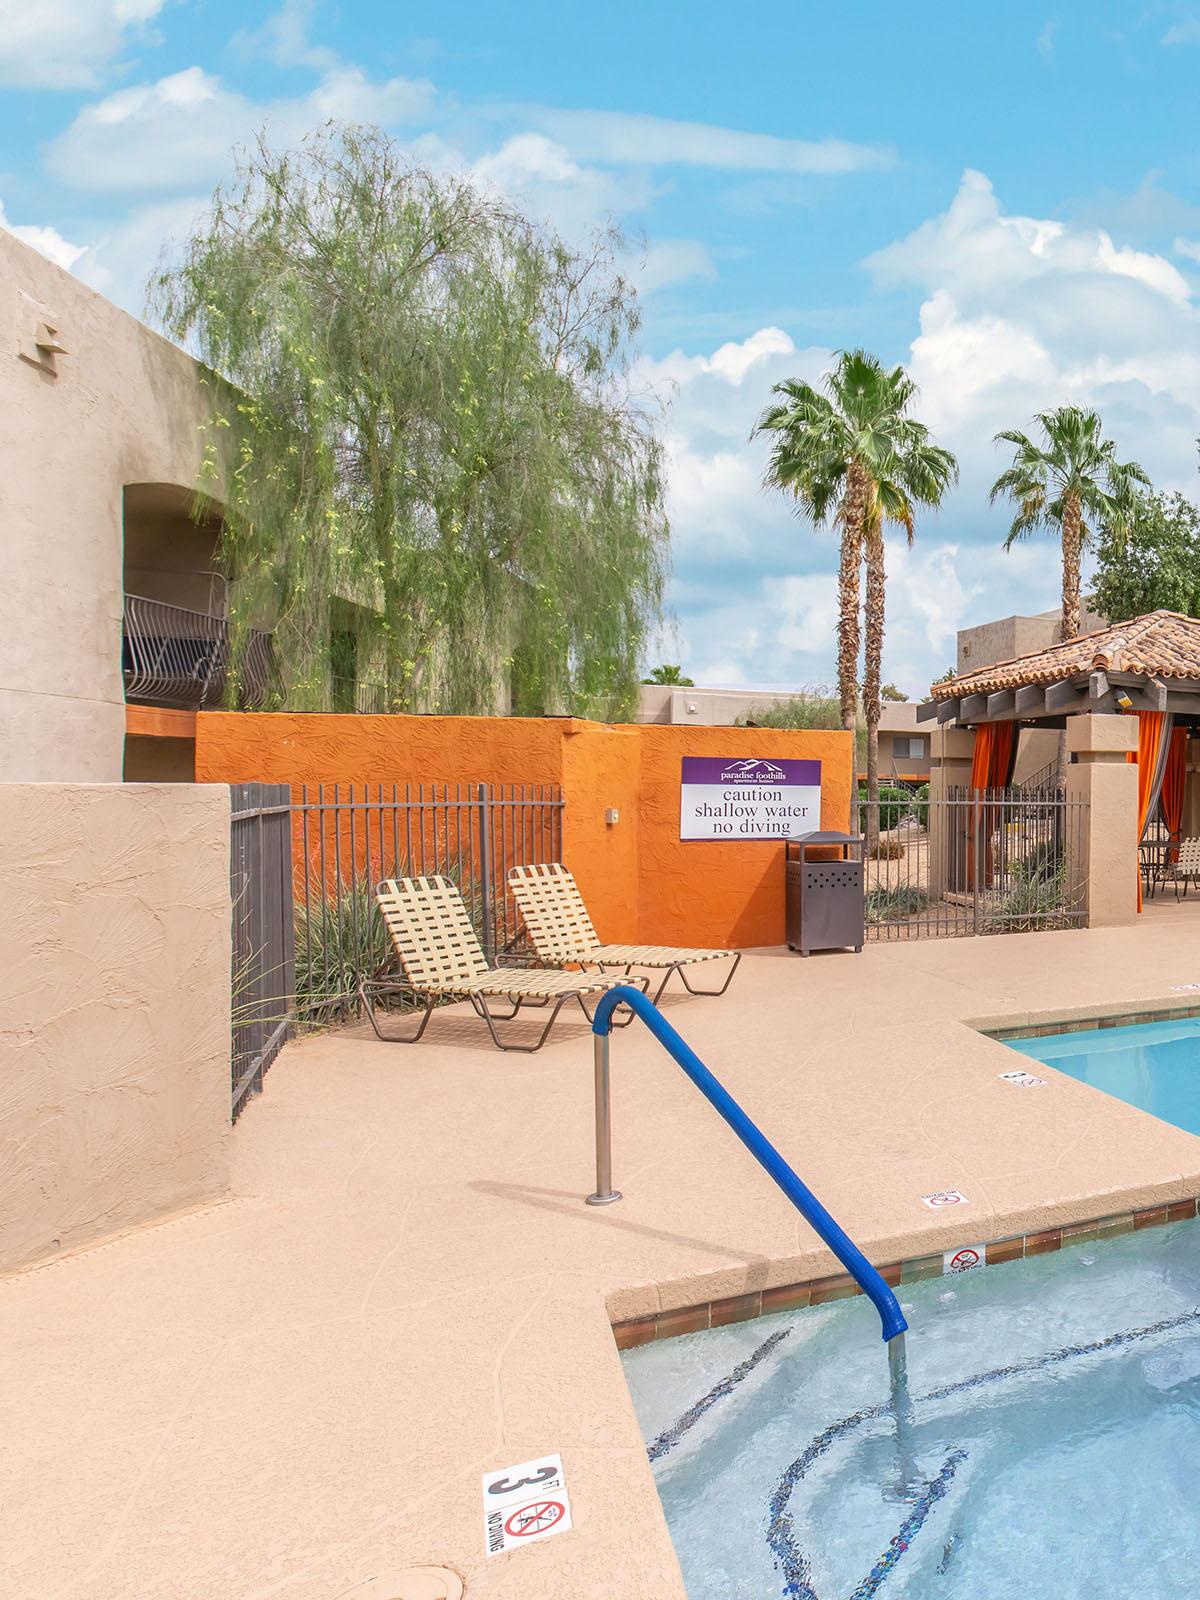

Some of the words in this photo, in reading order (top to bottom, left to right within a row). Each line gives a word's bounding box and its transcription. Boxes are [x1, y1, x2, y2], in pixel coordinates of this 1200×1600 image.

[721, 771, 754, 781] paradise
[756, 771, 786, 780] foothills
[723, 787, 782, 801] caution
[695, 803, 758, 817] shallow
[765, 806, 809, 817] water
[713, 822, 733, 833] no
[740, 819, 791, 836] diving
[488, 1466, 558, 1495] 3
[488, 1511, 502, 1525] NO
[488, 1523, 504, 1552] DIVING
